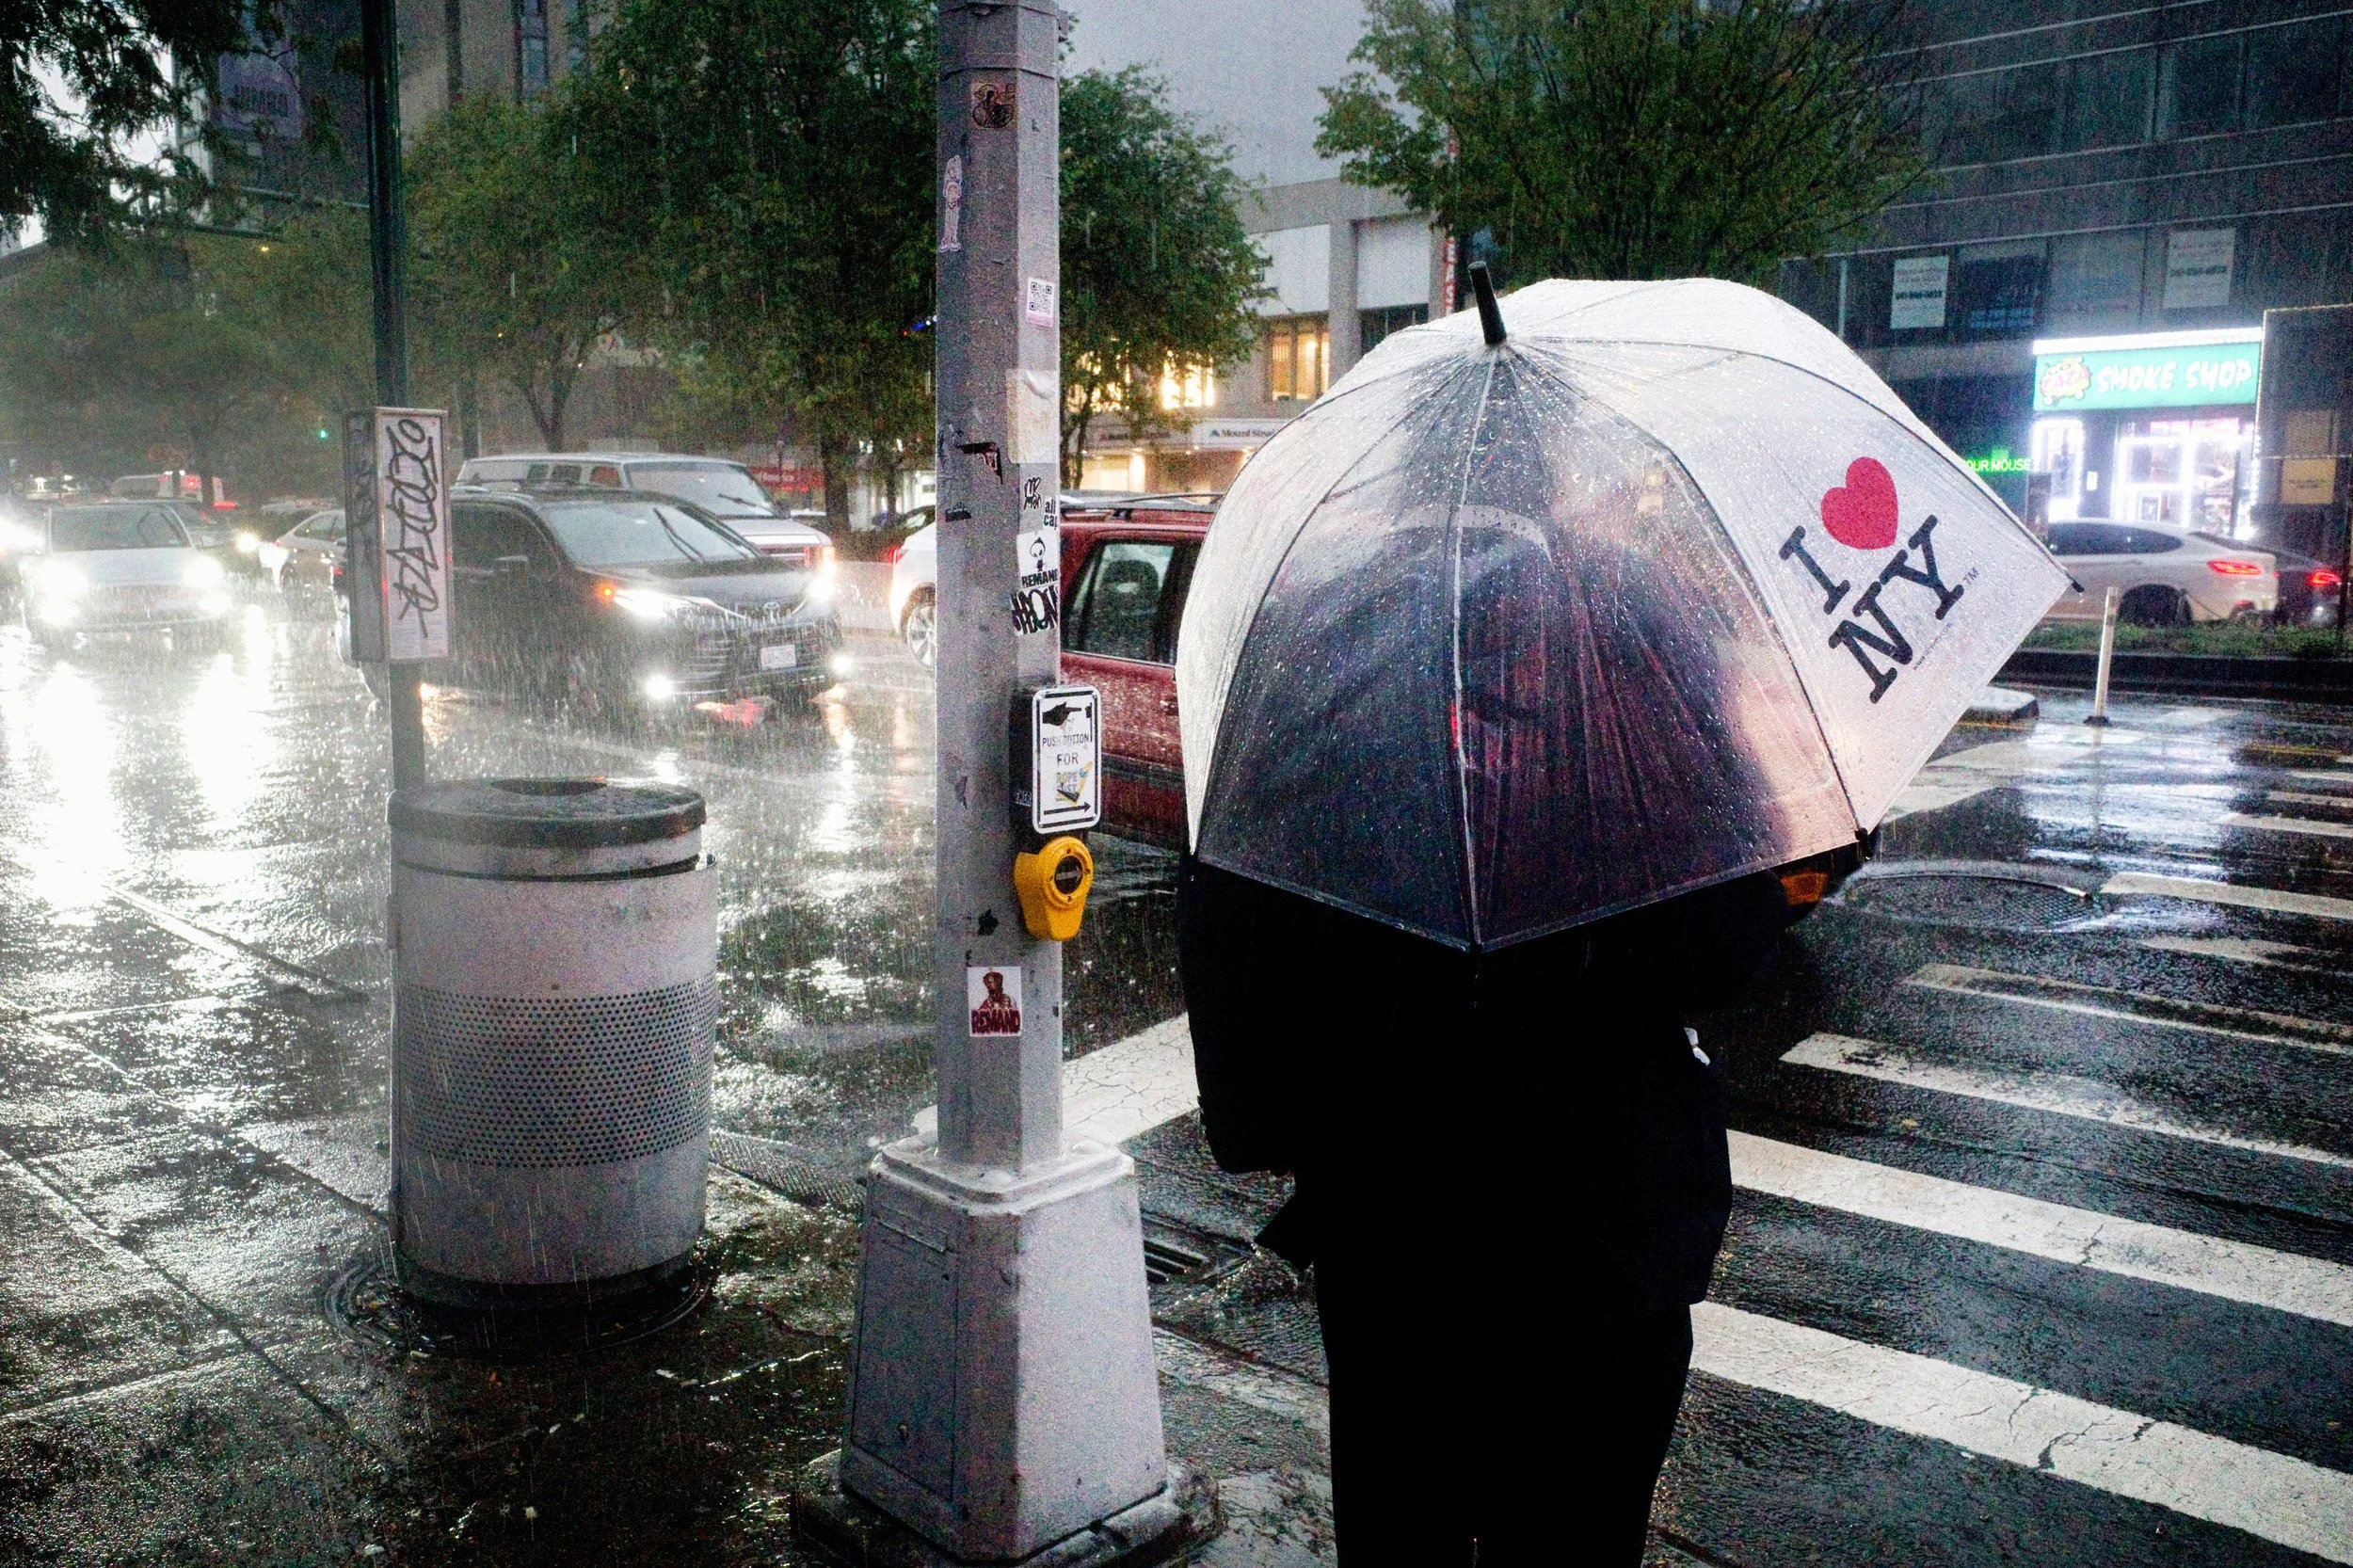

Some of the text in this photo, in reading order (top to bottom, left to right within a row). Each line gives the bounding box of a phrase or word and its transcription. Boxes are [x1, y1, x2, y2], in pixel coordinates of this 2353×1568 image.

[2097, 359, 2252, 392] SMOKE SHOP
[1779, 525, 1850, 615] I
[1828, 514, 1965, 704] NY
[1057, 753, 1078, 766] FOR
